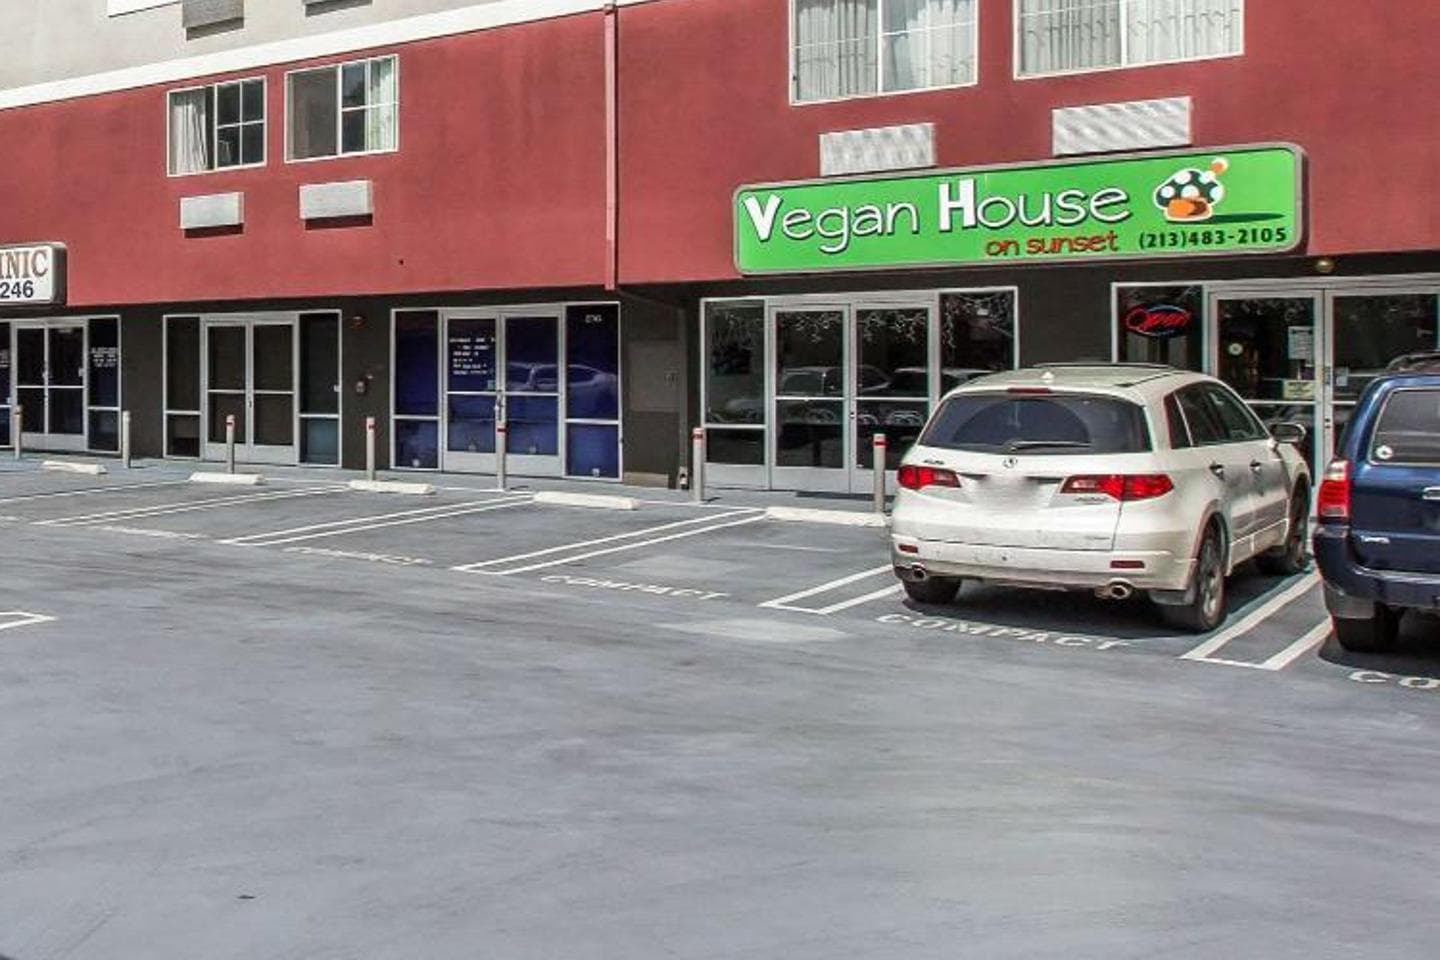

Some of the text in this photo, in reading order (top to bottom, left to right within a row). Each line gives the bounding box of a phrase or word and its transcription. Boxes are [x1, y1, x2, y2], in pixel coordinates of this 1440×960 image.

[742, 177, 1132, 254] Vegan House
[985, 230, 1119, 257] on sunset
[1138, 227, 1287, 249] (213)483-2105
[876, 613, 1132, 651] COMPACT
